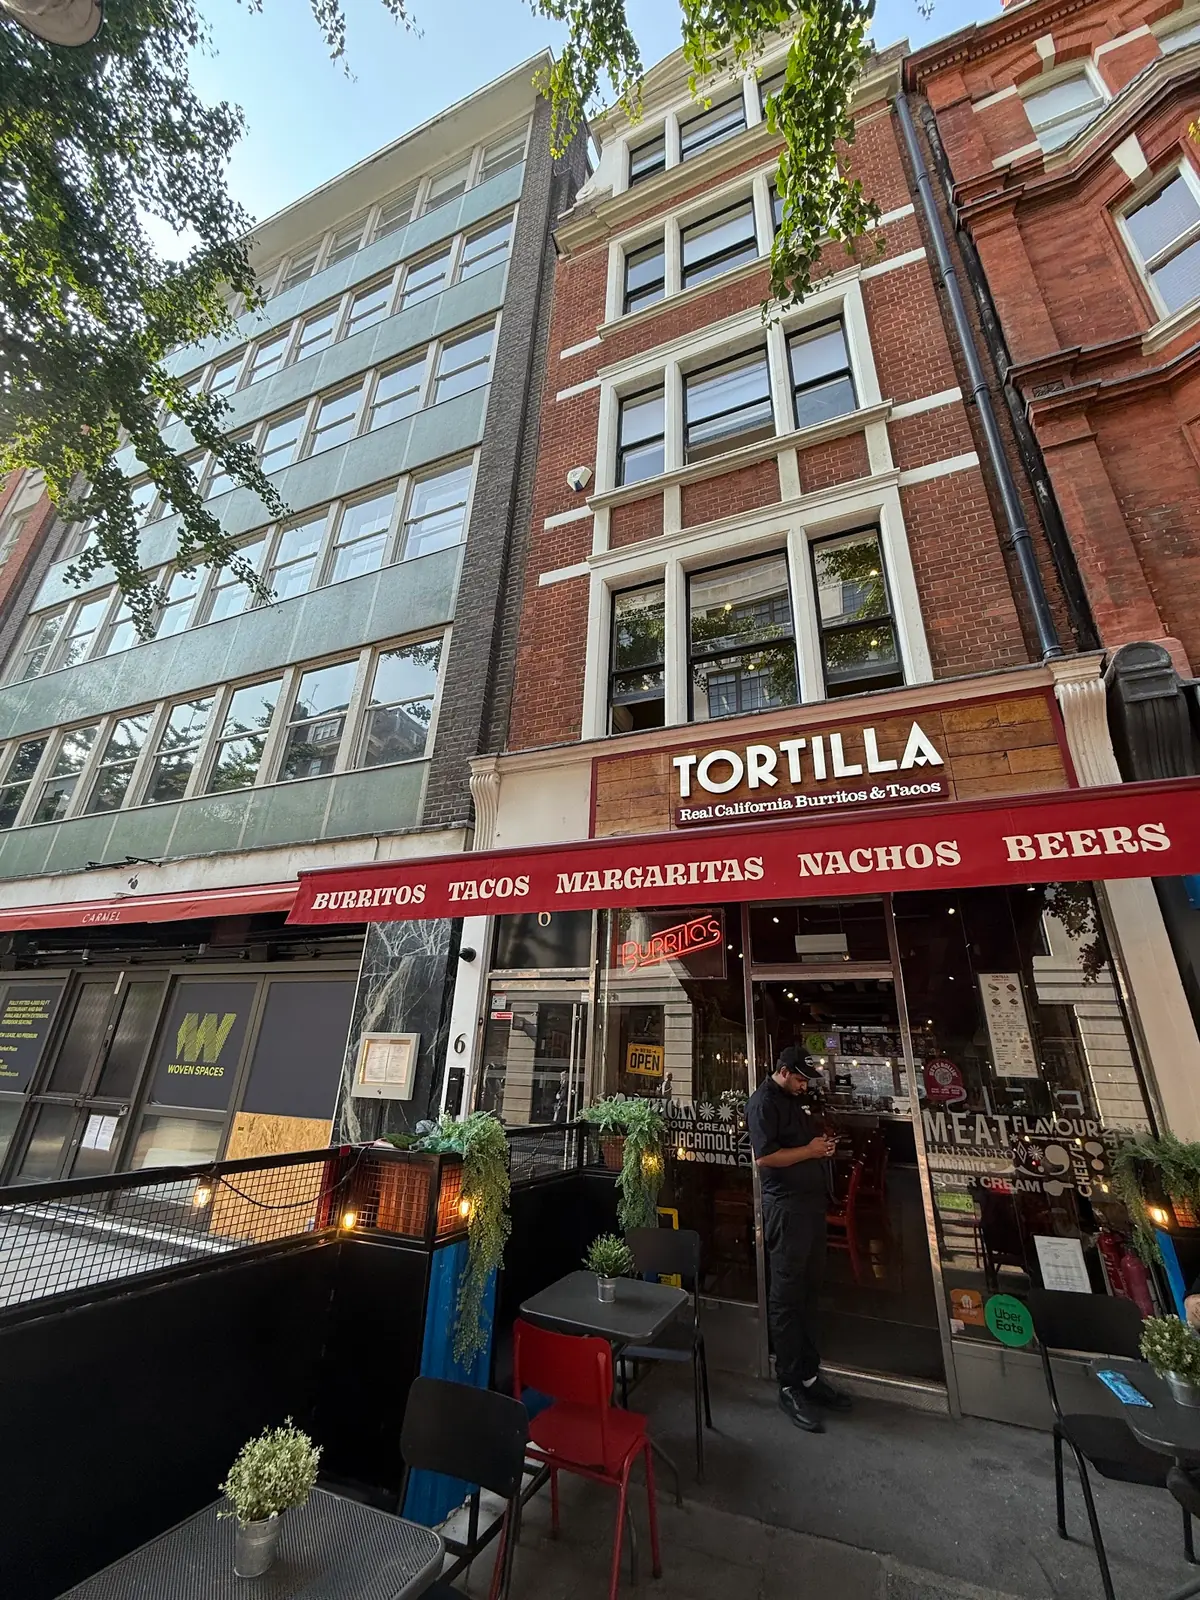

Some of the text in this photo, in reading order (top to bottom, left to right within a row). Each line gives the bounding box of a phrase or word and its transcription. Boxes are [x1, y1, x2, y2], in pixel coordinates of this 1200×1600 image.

[672, 721, 945, 798] TORTILLA
[679, 781, 942, 821] Real California Burritos & Tacos
[311, 822, 1172, 910] BURRITOS TACOS MARGARITAS NACHOS BEERS
[82, 911, 121, 923] CARMEL
[622, 915, 721, 972] BURRITOS
[454, 1033, 467, 1054] 6
[167, 1065, 225, 1077] WOVEN SPACES
[630, 1052, 660, 1071] OPEN
[696, 1121, 735, 1133] CREAM
[1012, 1115, 1099, 1138] FLAVOUR
[664, 1130, 737, 1152] GUACAMOLE
[928, 1144, 1015, 1160] HABANERO
[931, 1171, 1041, 1193] SOUR CREAM
[994, 1308, 1022, 1323] Uber
[996, 1319, 1024, 1335] Eats
